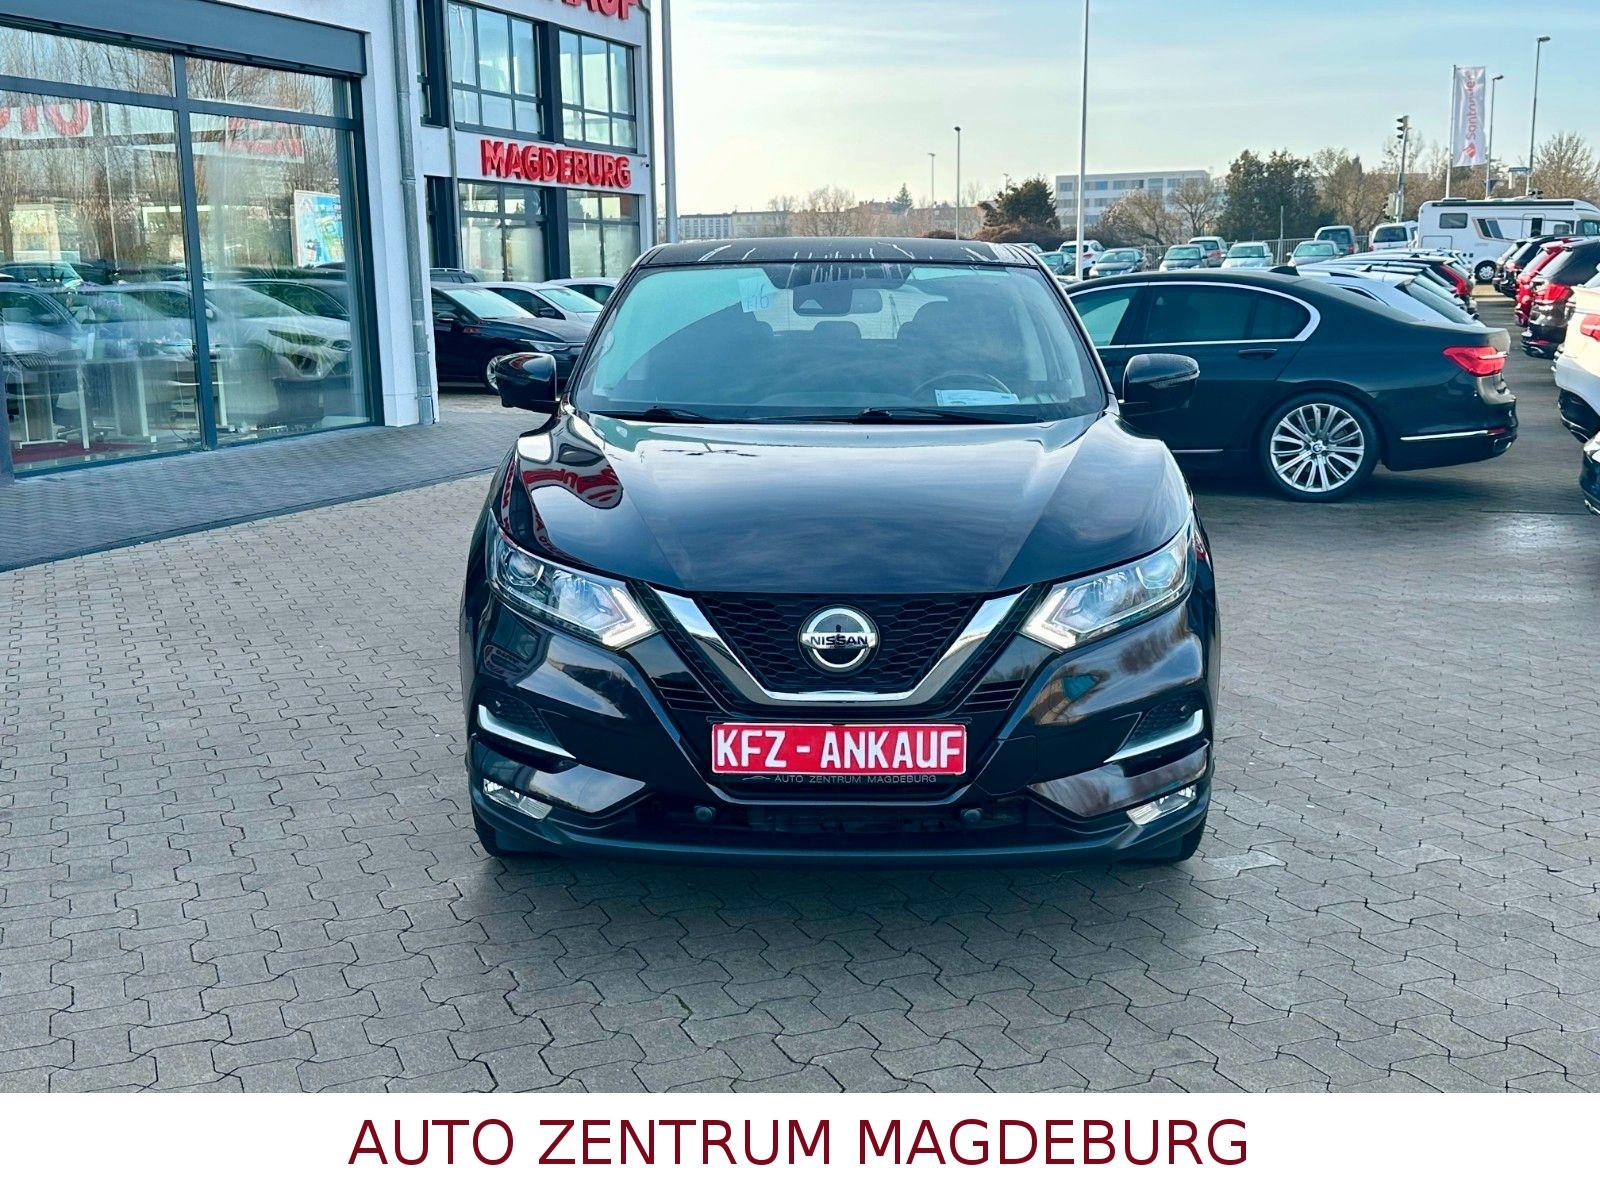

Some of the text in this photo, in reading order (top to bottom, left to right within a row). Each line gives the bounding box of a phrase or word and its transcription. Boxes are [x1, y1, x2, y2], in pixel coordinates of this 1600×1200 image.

[480, 139, 631, 188] MAGDEBURG
[811, 634, 868, 646] NISSAN
[716, 729, 787, 767] KFZ
[820, 730, 963, 769] ANKAUF
[774, 774, 937, 784] AUTO ZENTRUM MAGDEBURG
